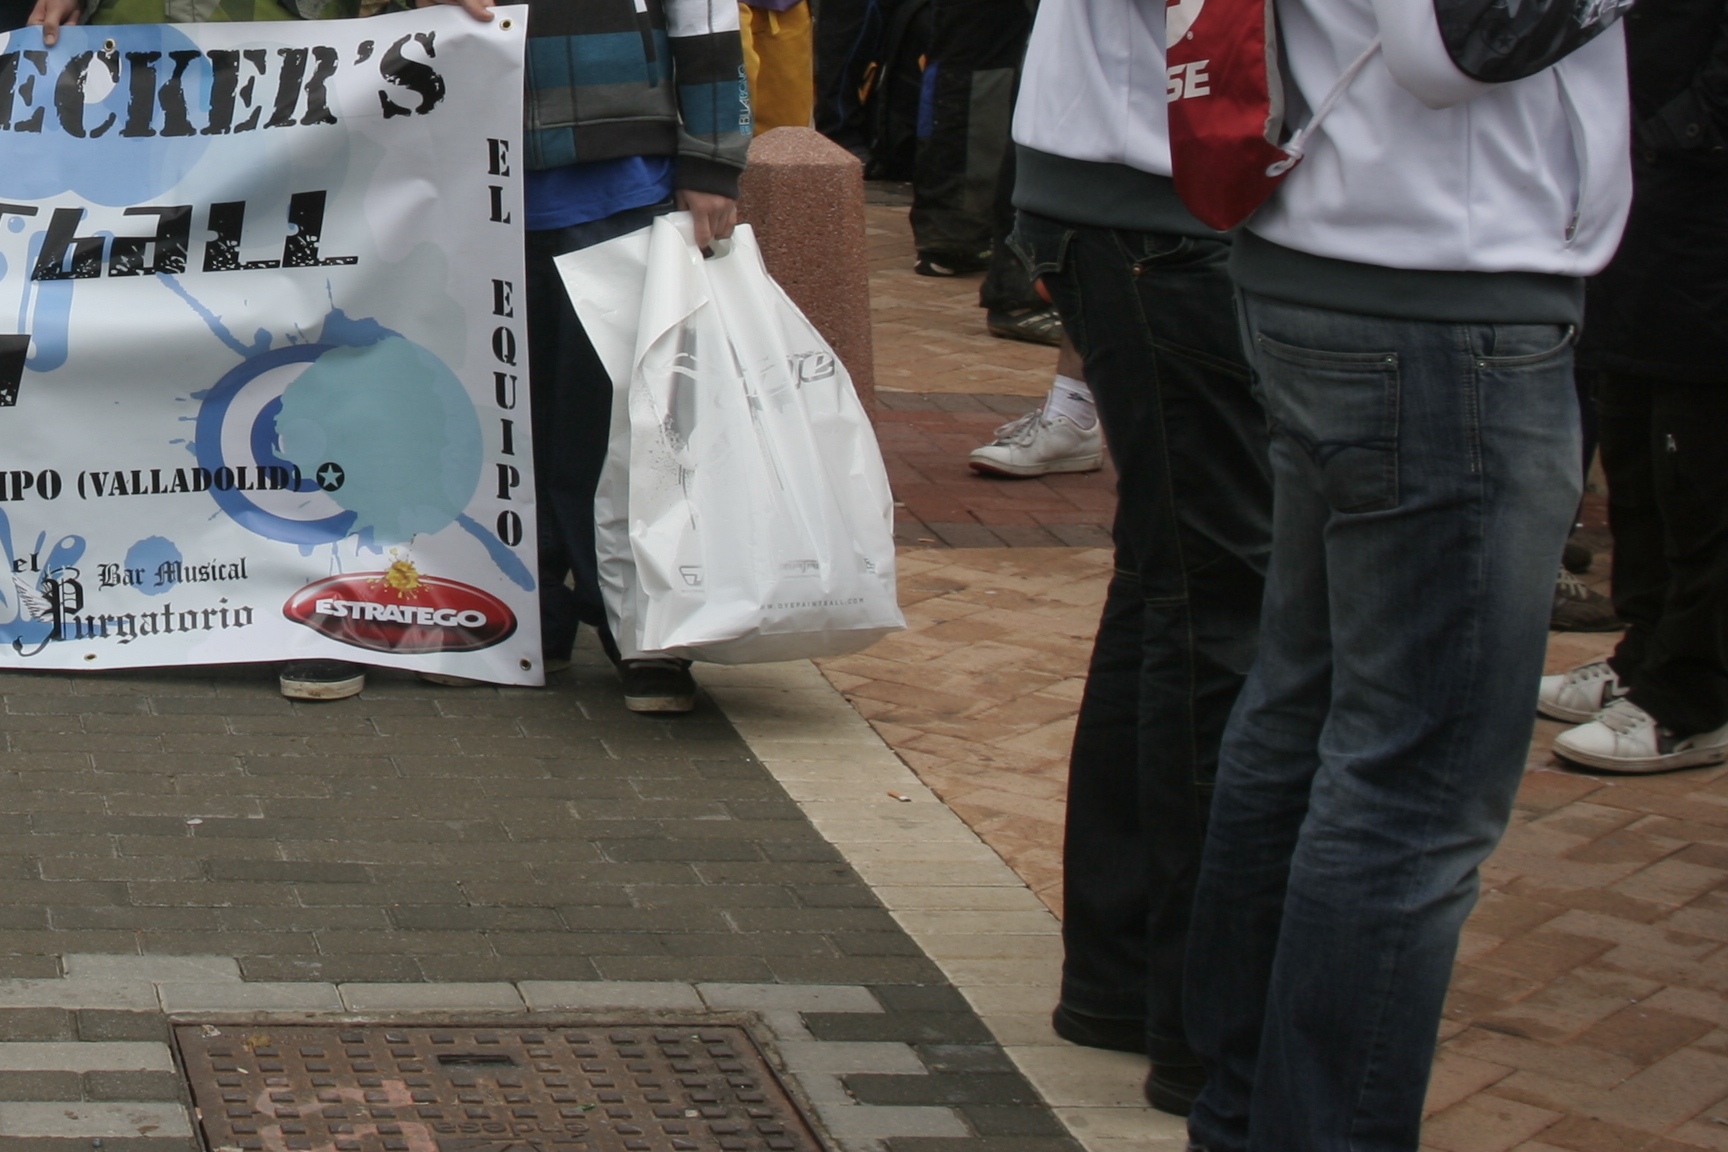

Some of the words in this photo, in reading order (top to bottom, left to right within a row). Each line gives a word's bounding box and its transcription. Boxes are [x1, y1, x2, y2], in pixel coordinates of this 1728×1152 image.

[487, 138, 511, 224] EL
[491, 278, 523, 548] EQUIPO
[77, 463, 302, 499] (VALLADOLID)
[11, 552, 40, 573] el
[97, 563, 145, 591] Bar
[154, 557, 248, 587] Musical
[17, 572, 254, 654] Purgatorio
[315, 599, 487, 628] ESTRATEGO
